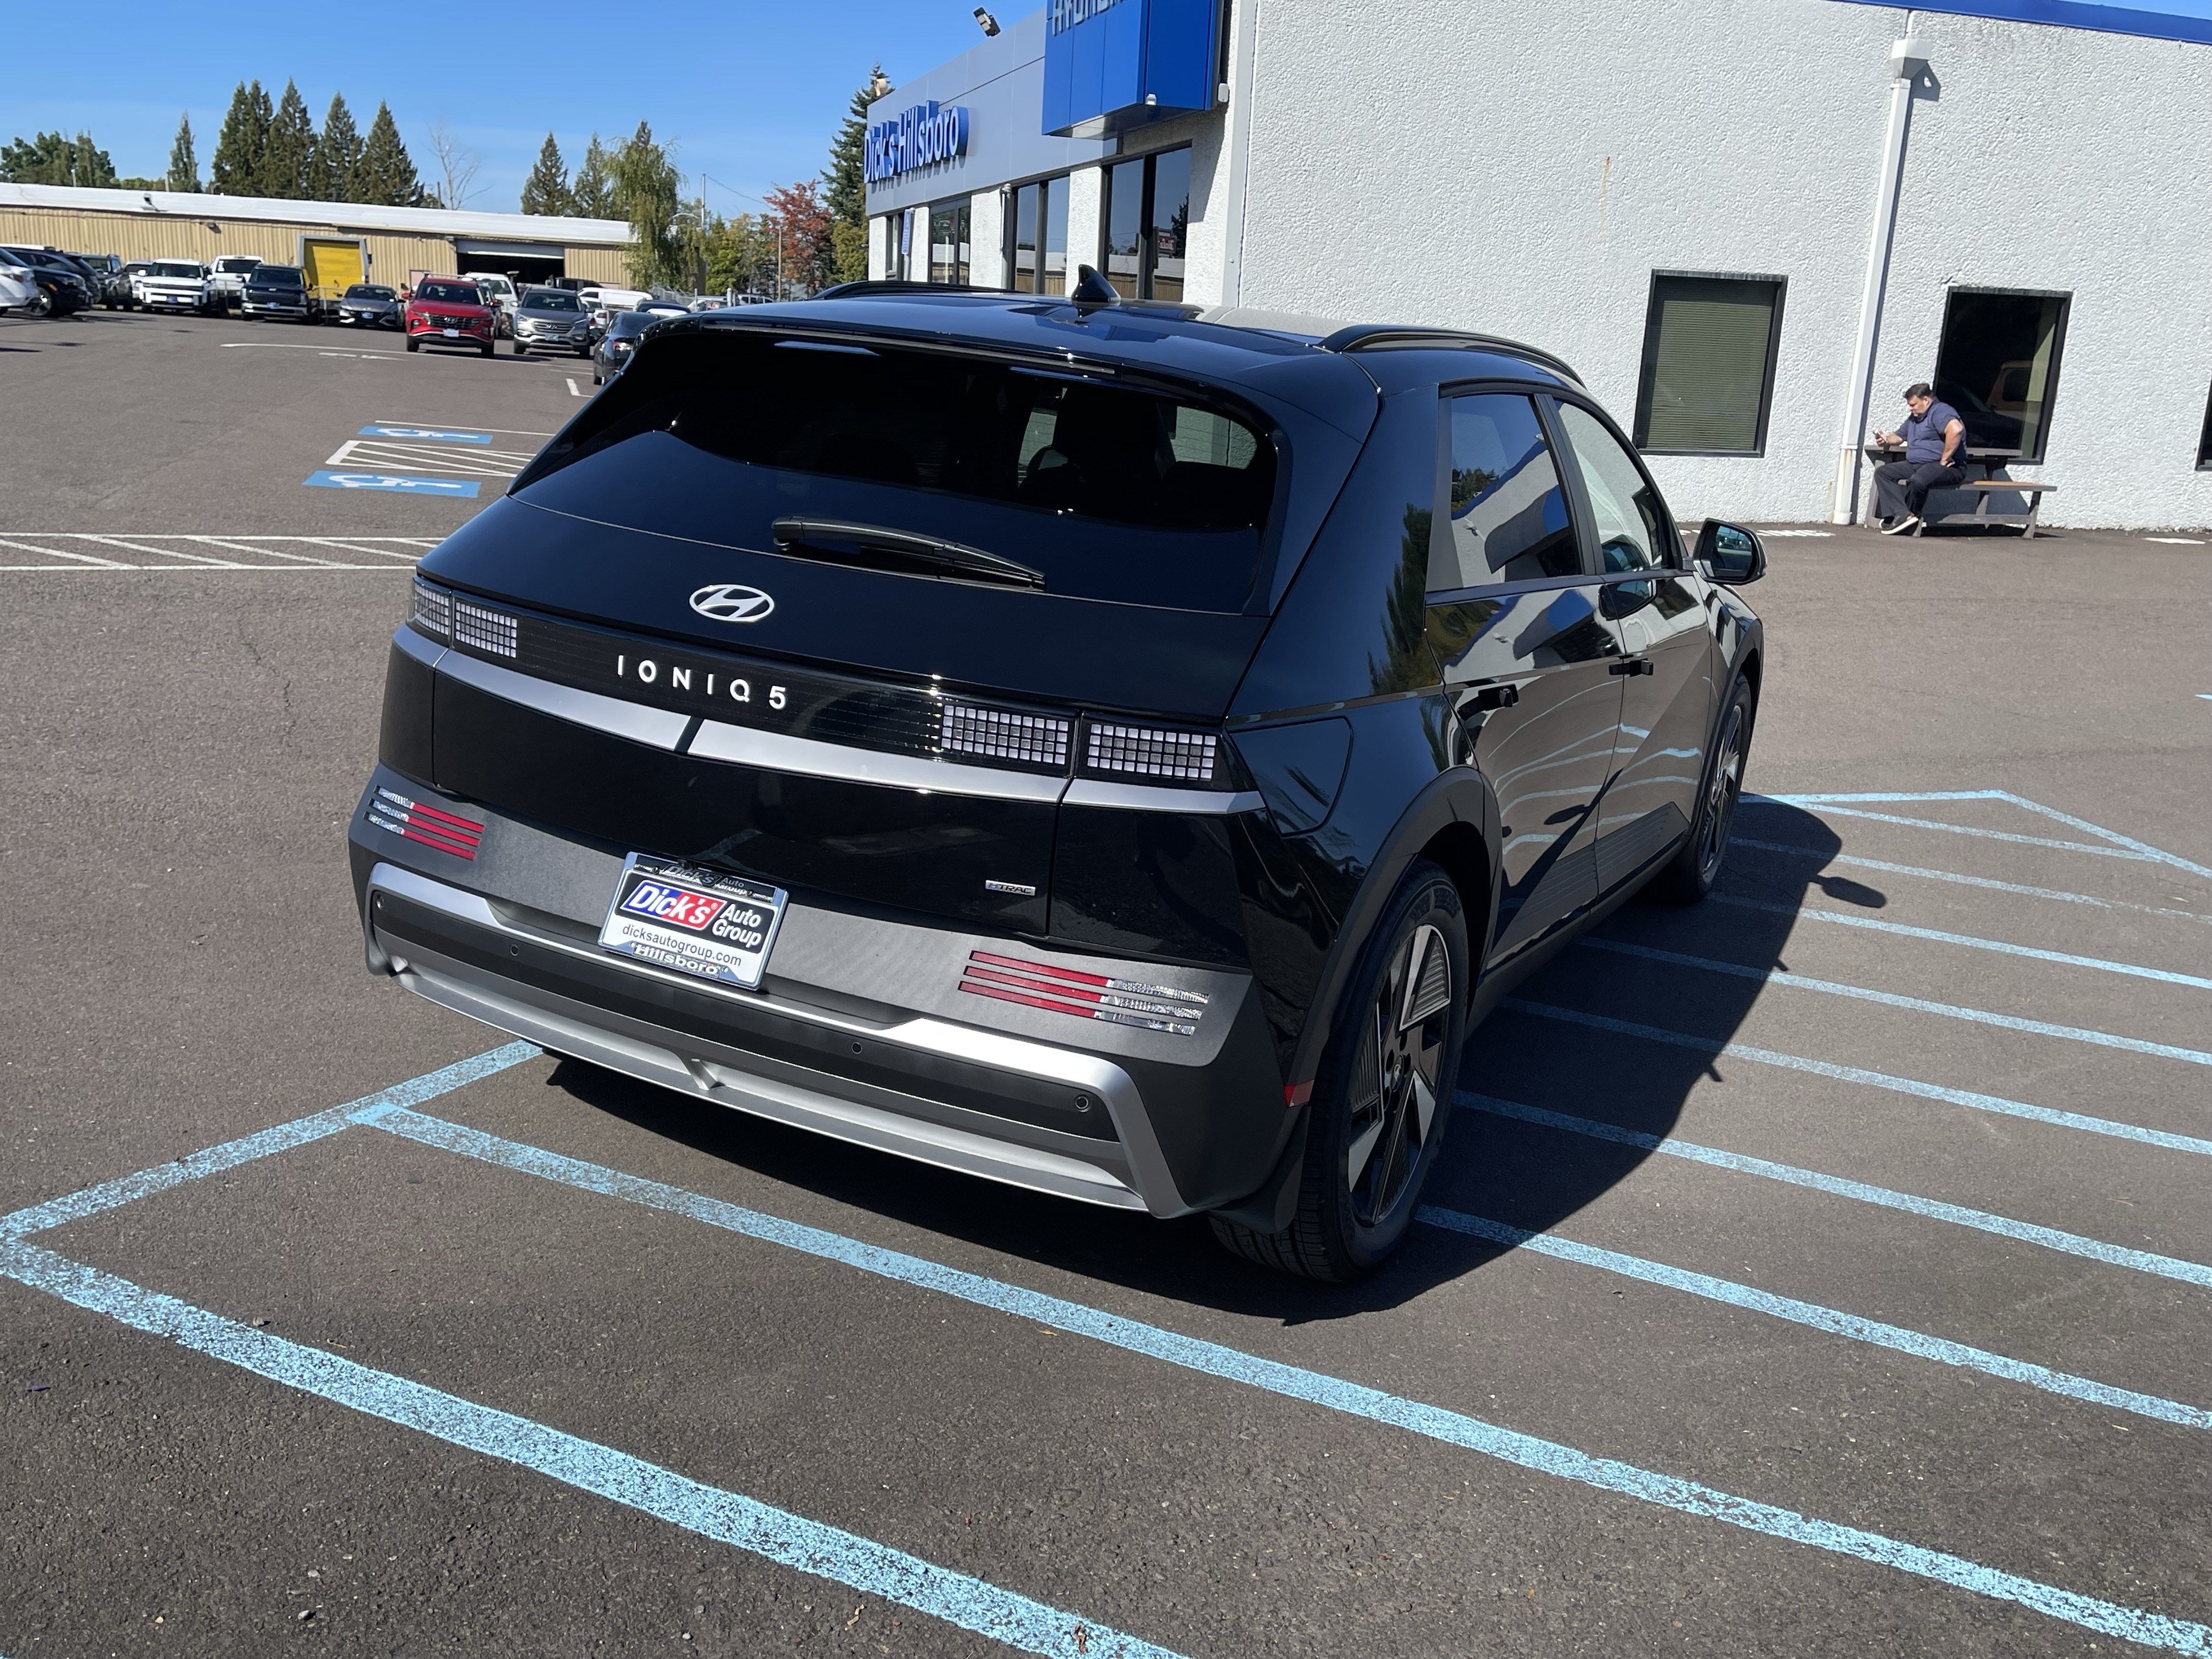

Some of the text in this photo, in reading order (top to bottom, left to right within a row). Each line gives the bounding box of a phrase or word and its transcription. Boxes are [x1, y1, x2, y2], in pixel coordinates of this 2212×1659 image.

[864, 100, 961, 183] Dick's Hillsboro
[617, 654, 786, 709] IONIQ 5
[719, 877, 745, 888] Auto
[628, 884, 761, 927] Dick's Auto
[622, 924, 742, 967] dicksautogroup.com
[712, 918, 761, 948] Group
[634, 944, 720, 975] Hillsboro
